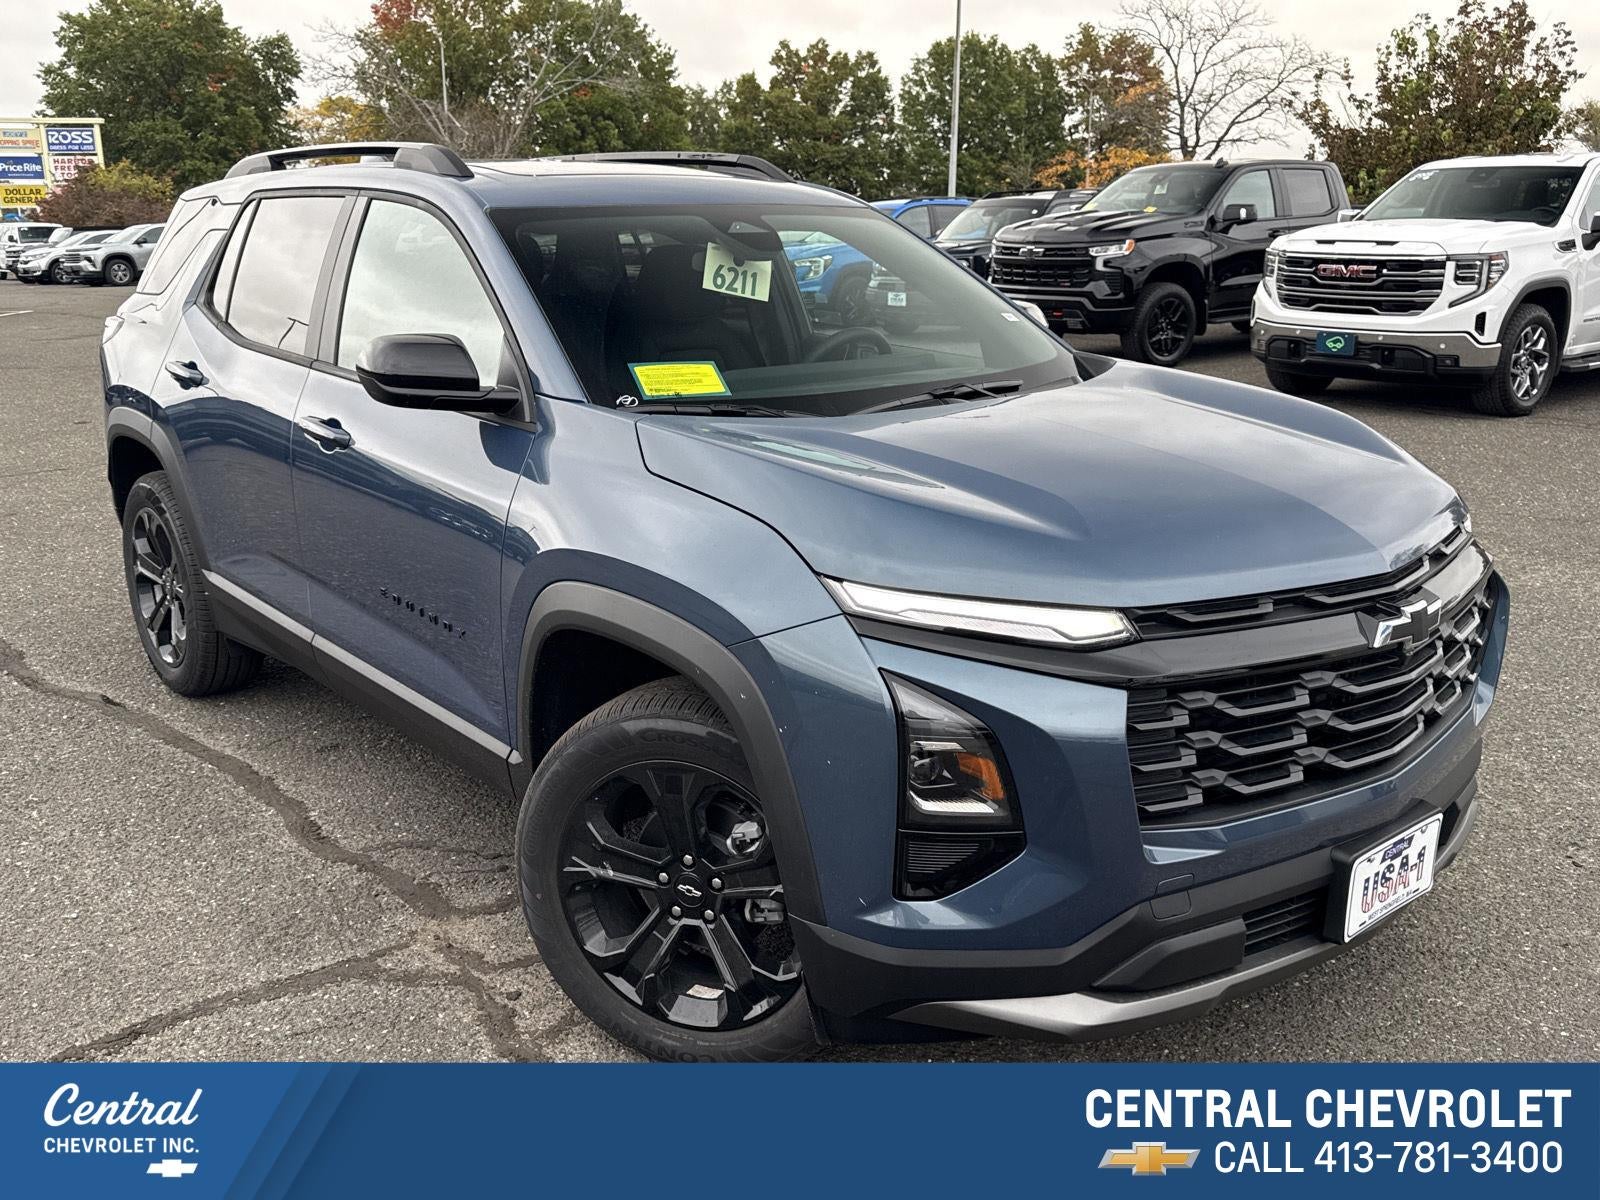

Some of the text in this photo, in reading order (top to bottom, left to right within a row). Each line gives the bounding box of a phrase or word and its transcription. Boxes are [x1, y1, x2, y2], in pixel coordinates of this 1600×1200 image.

[47, 131, 93, 144] ROSS
[0, 163, 42, 171] Price Rite
[4, 188, 42, 196] DOLLAR
[1317, 263, 1378, 278] GMC
[712, 264, 758, 297] 6211
[1361, 845, 1427, 914] USA-1
